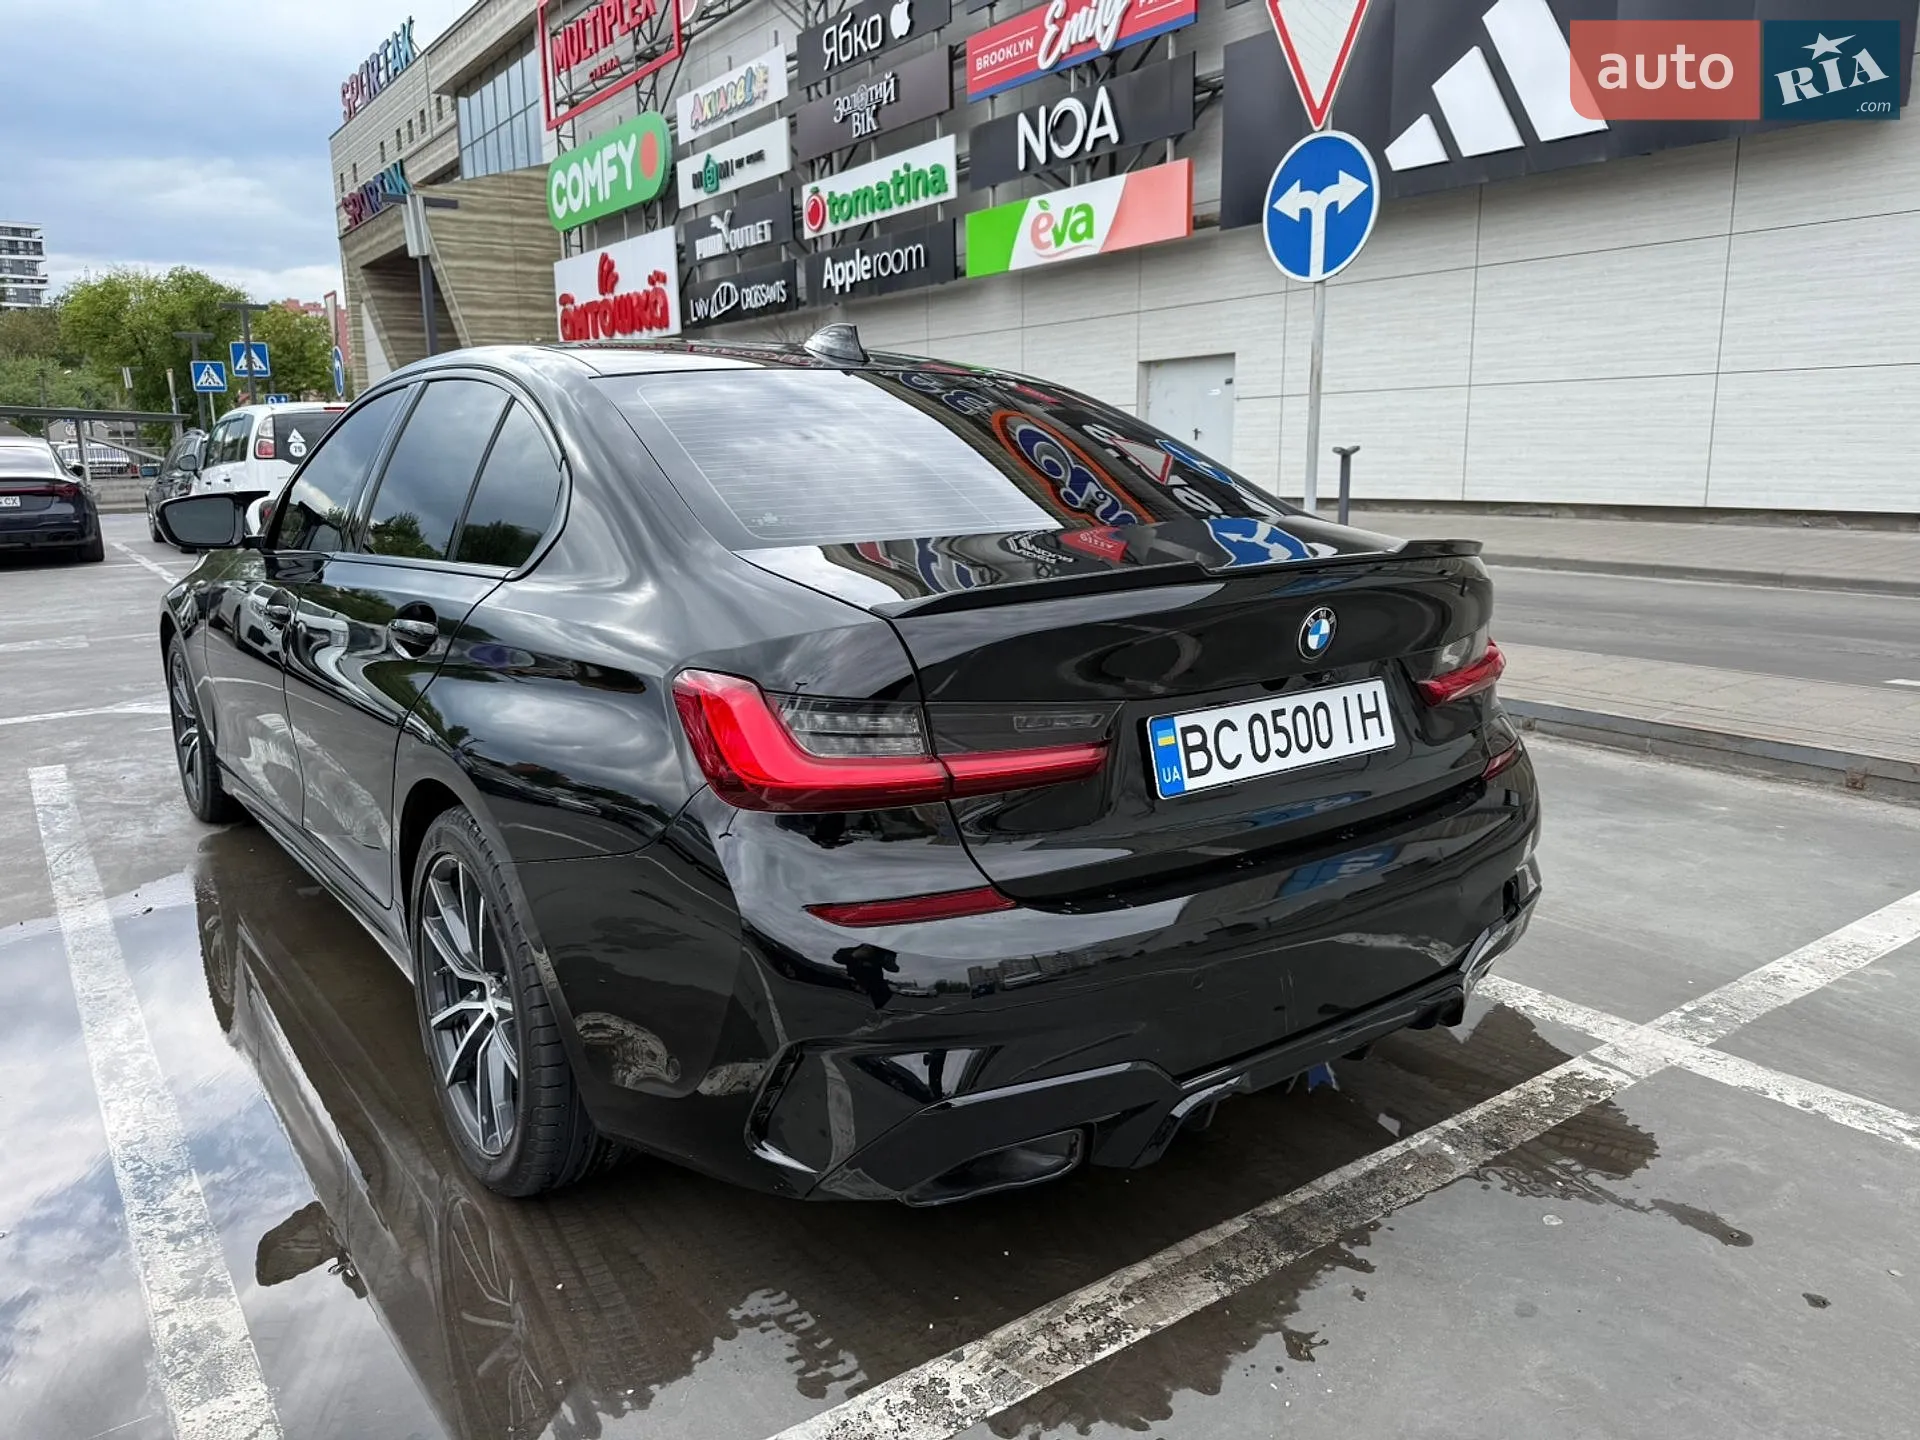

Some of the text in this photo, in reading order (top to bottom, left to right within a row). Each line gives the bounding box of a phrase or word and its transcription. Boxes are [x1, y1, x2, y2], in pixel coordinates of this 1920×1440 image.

[588, 55, 622, 82] CINEMA
[976, 0, 1131, 72] BROOKLYN Emily
[1017, 85, 1120, 171] NOA
[551, 134, 637, 219] COMFY
[827, 163, 949, 224] tomatina
[729, 219, 773, 252] OUTLET
[1180, 690, 1386, 779] BC 0500 IH
[1162, 765, 1182, 784] UA
